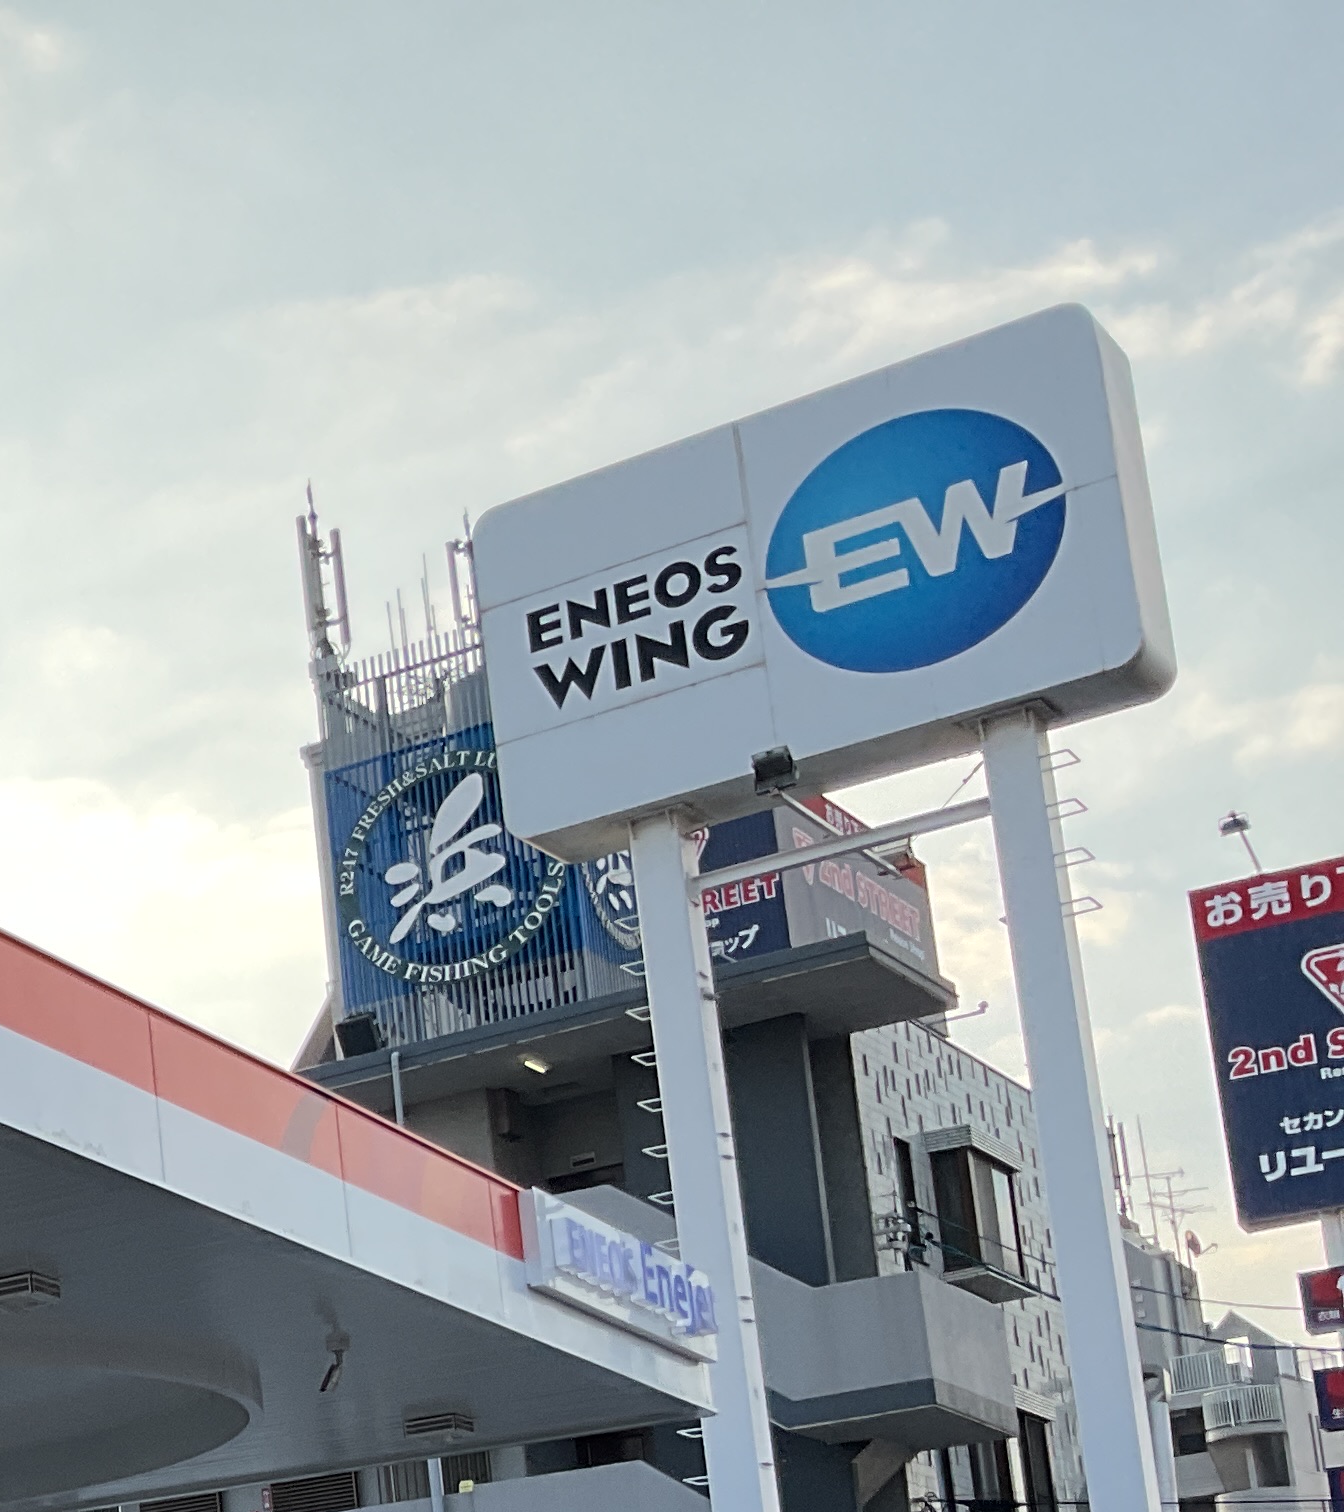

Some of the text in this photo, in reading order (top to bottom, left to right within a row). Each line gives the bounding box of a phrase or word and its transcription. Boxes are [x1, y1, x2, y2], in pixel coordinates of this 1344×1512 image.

[803, 460, 1028, 612] EW
[526, 546, 742, 654] ENEOS
[533, 605, 749, 710] WING
[348, 919, 401, 975] GAME
[403, 945, 507, 983] FISHING
[509, 861, 566, 945] TOOLS
[1205, 865, 1344, 927] お売り
[1228, 1033, 1318, 1080] 2nd
